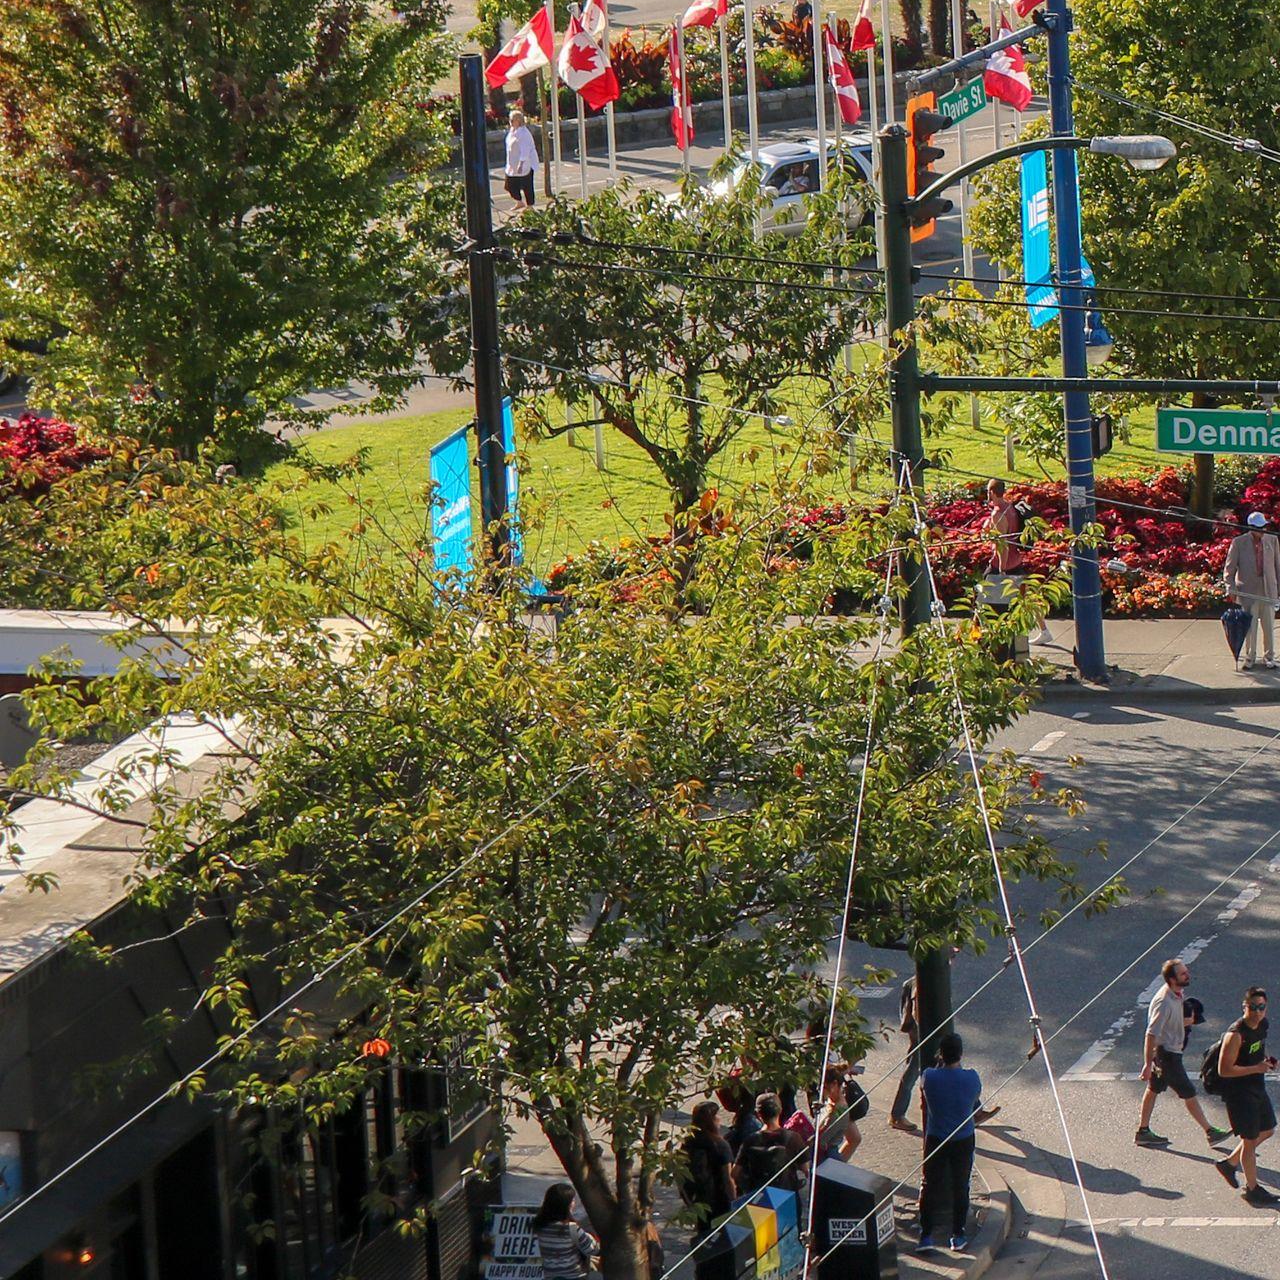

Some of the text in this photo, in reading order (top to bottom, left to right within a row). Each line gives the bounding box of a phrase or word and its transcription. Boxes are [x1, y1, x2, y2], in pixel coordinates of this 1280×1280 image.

[942, 85, 983, 121] Davie St
[499, 1216, 535, 1235] DRIN
[501, 1236, 539, 1255] HERE
[488, 1264, 545, 1278] HAPPY HOUR
